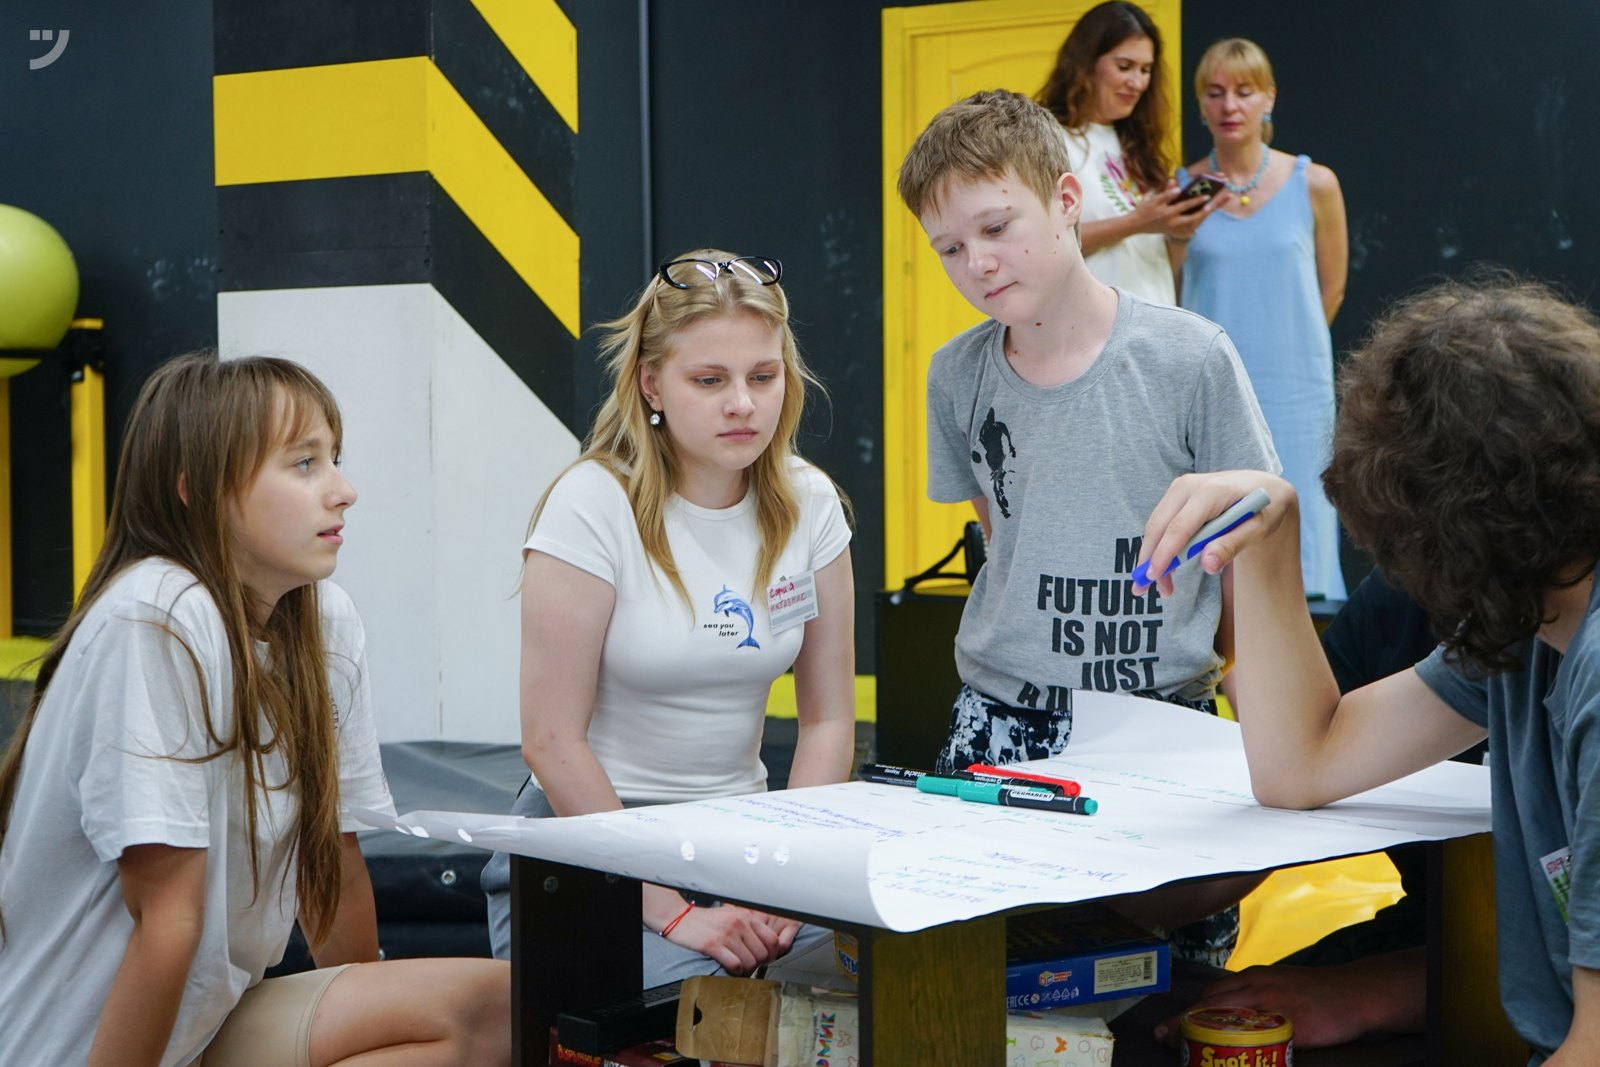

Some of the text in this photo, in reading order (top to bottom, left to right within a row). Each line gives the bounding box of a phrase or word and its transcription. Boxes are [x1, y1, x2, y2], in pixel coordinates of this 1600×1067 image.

[1114, 535, 1145, 573] M
[1037, 573, 1163, 616] FUTURE
[719, 622, 735, 630] you
[1052, 617, 1163, 656] IS NOT
[1081, 656, 1160, 693] JUST
[1011, 790, 1053, 799] PERMANENT
